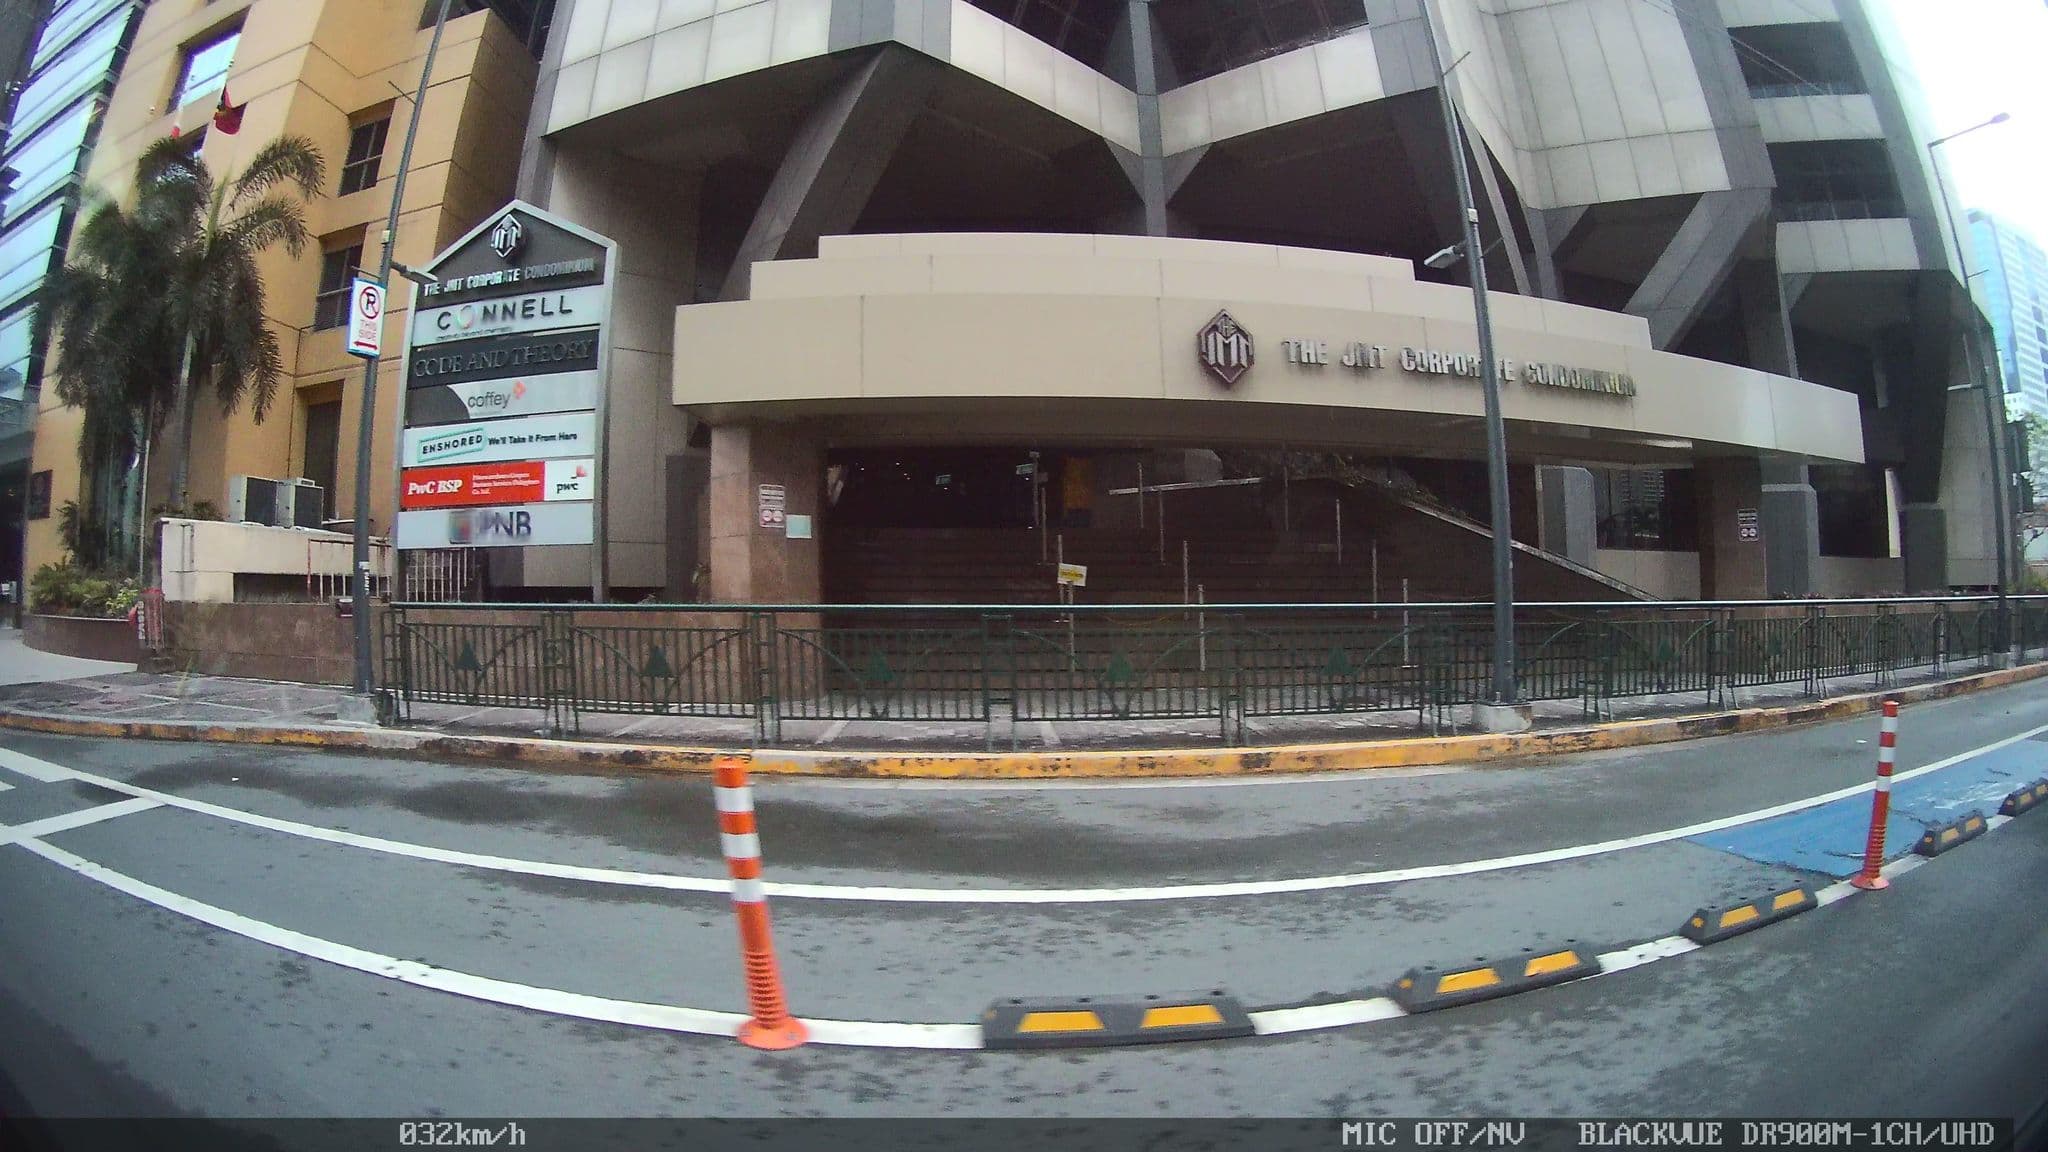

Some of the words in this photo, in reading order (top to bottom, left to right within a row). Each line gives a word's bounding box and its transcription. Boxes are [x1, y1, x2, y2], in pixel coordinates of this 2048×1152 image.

[424, 282, 440, 296] THE
[467, 268, 520, 289] CORPORATE
[525, 258, 595, 279] CONDOMINIUM
[437, 295, 573, 330] CONNELL
[415, 353, 463, 377] CODE
[467, 349, 507, 371] AND
[512, 339, 592, 366] THEORY
[1282, 339, 1329, 365] THE
[1400, 346, 1516, 382] CORPORTE
[1522, 361, 1637, 396] CONDOMINIUM
[467, 391, 510, 410] coffey
[422, 434, 483, 455] ENSHORED
[508, 435, 526, 444] Take
[535, 433, 556, 442] From
[558, 432, 577, 441] Here
[408, 480, 435, 495] PwC
[437, 479, 463, 494] BSP
[556, 482, 578, 494] pwc
